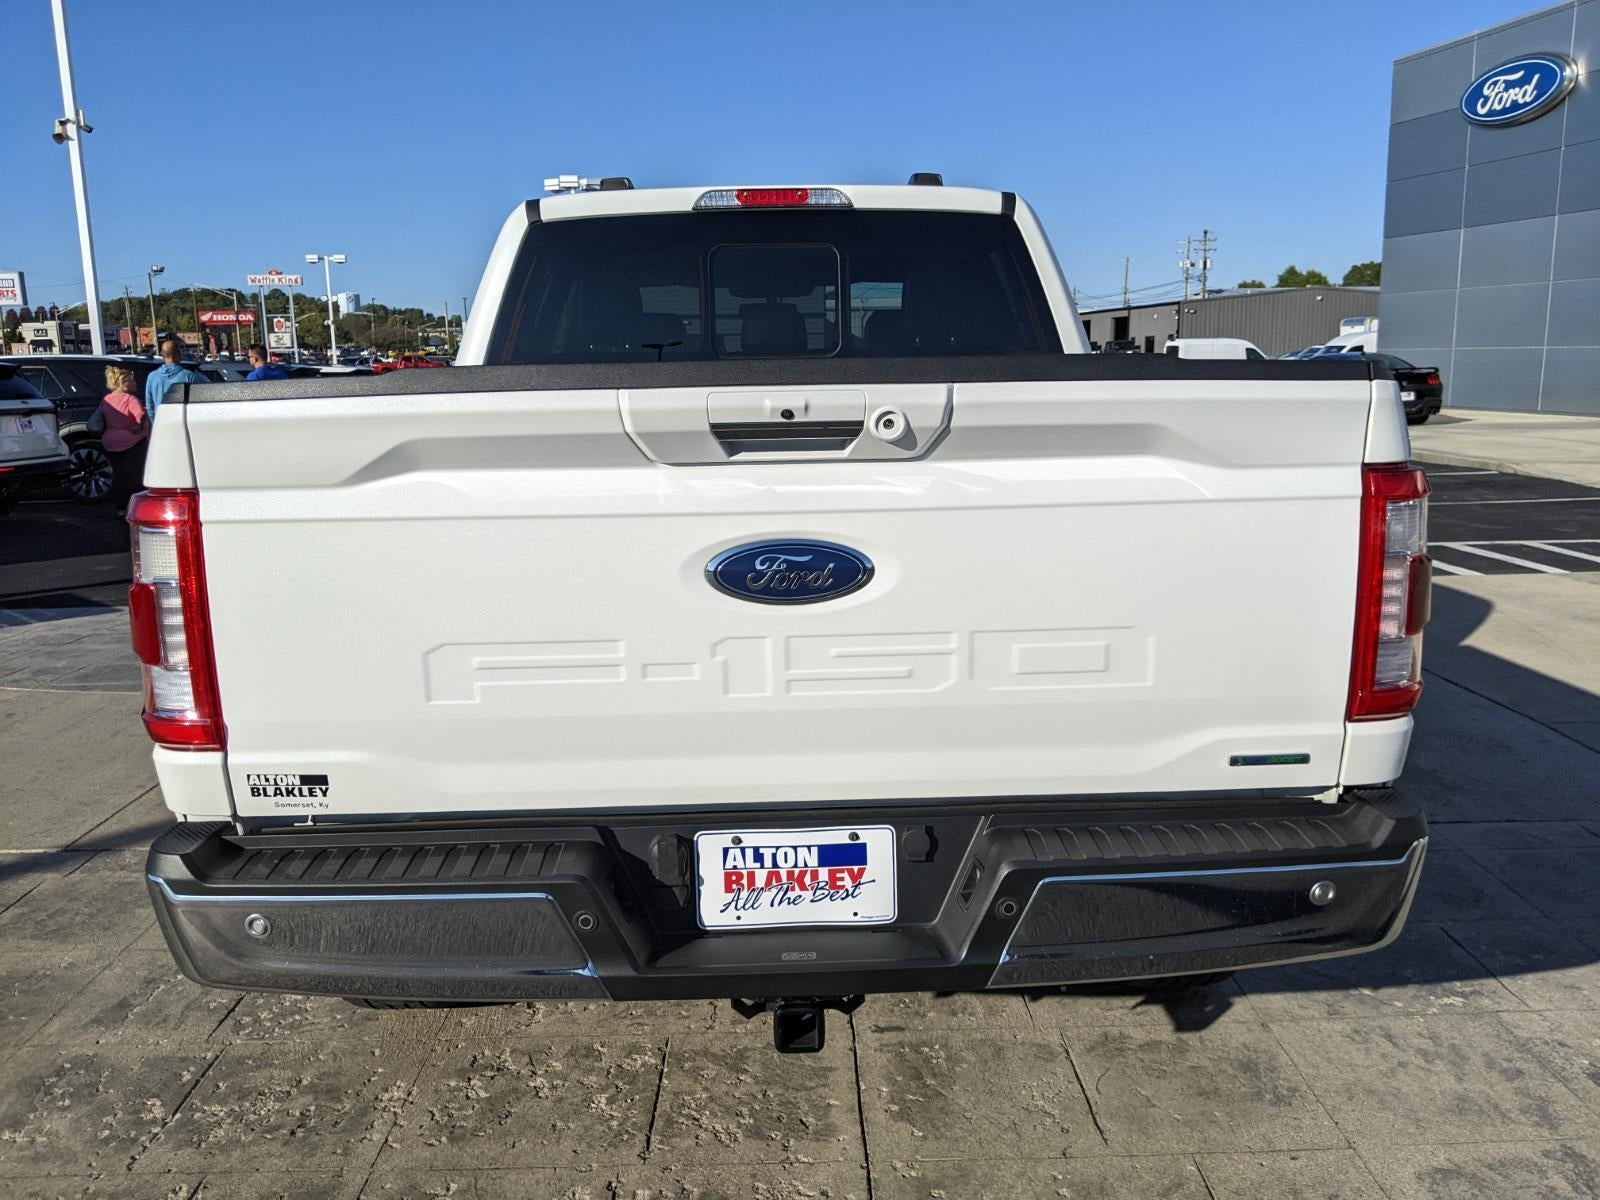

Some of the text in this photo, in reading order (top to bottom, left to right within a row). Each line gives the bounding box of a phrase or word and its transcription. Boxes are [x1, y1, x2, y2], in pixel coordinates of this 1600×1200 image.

[1476, 70, 1541, 115] Ford
[277, 276, 299, 284] King
[745, 553, 836, 591] Ford
[423, 626, 1157, 706] F-150
[247, 774, 301, 786] ALTON
[249, 787, 330, 798] BLAKLEY
[274, 801, 329, 809] Somerset, Ky
[724, 845, 819, 870] ALTON
[723, 867, 867, 894] BLAKLEY
[719, 878, 877, 914] All The Best
